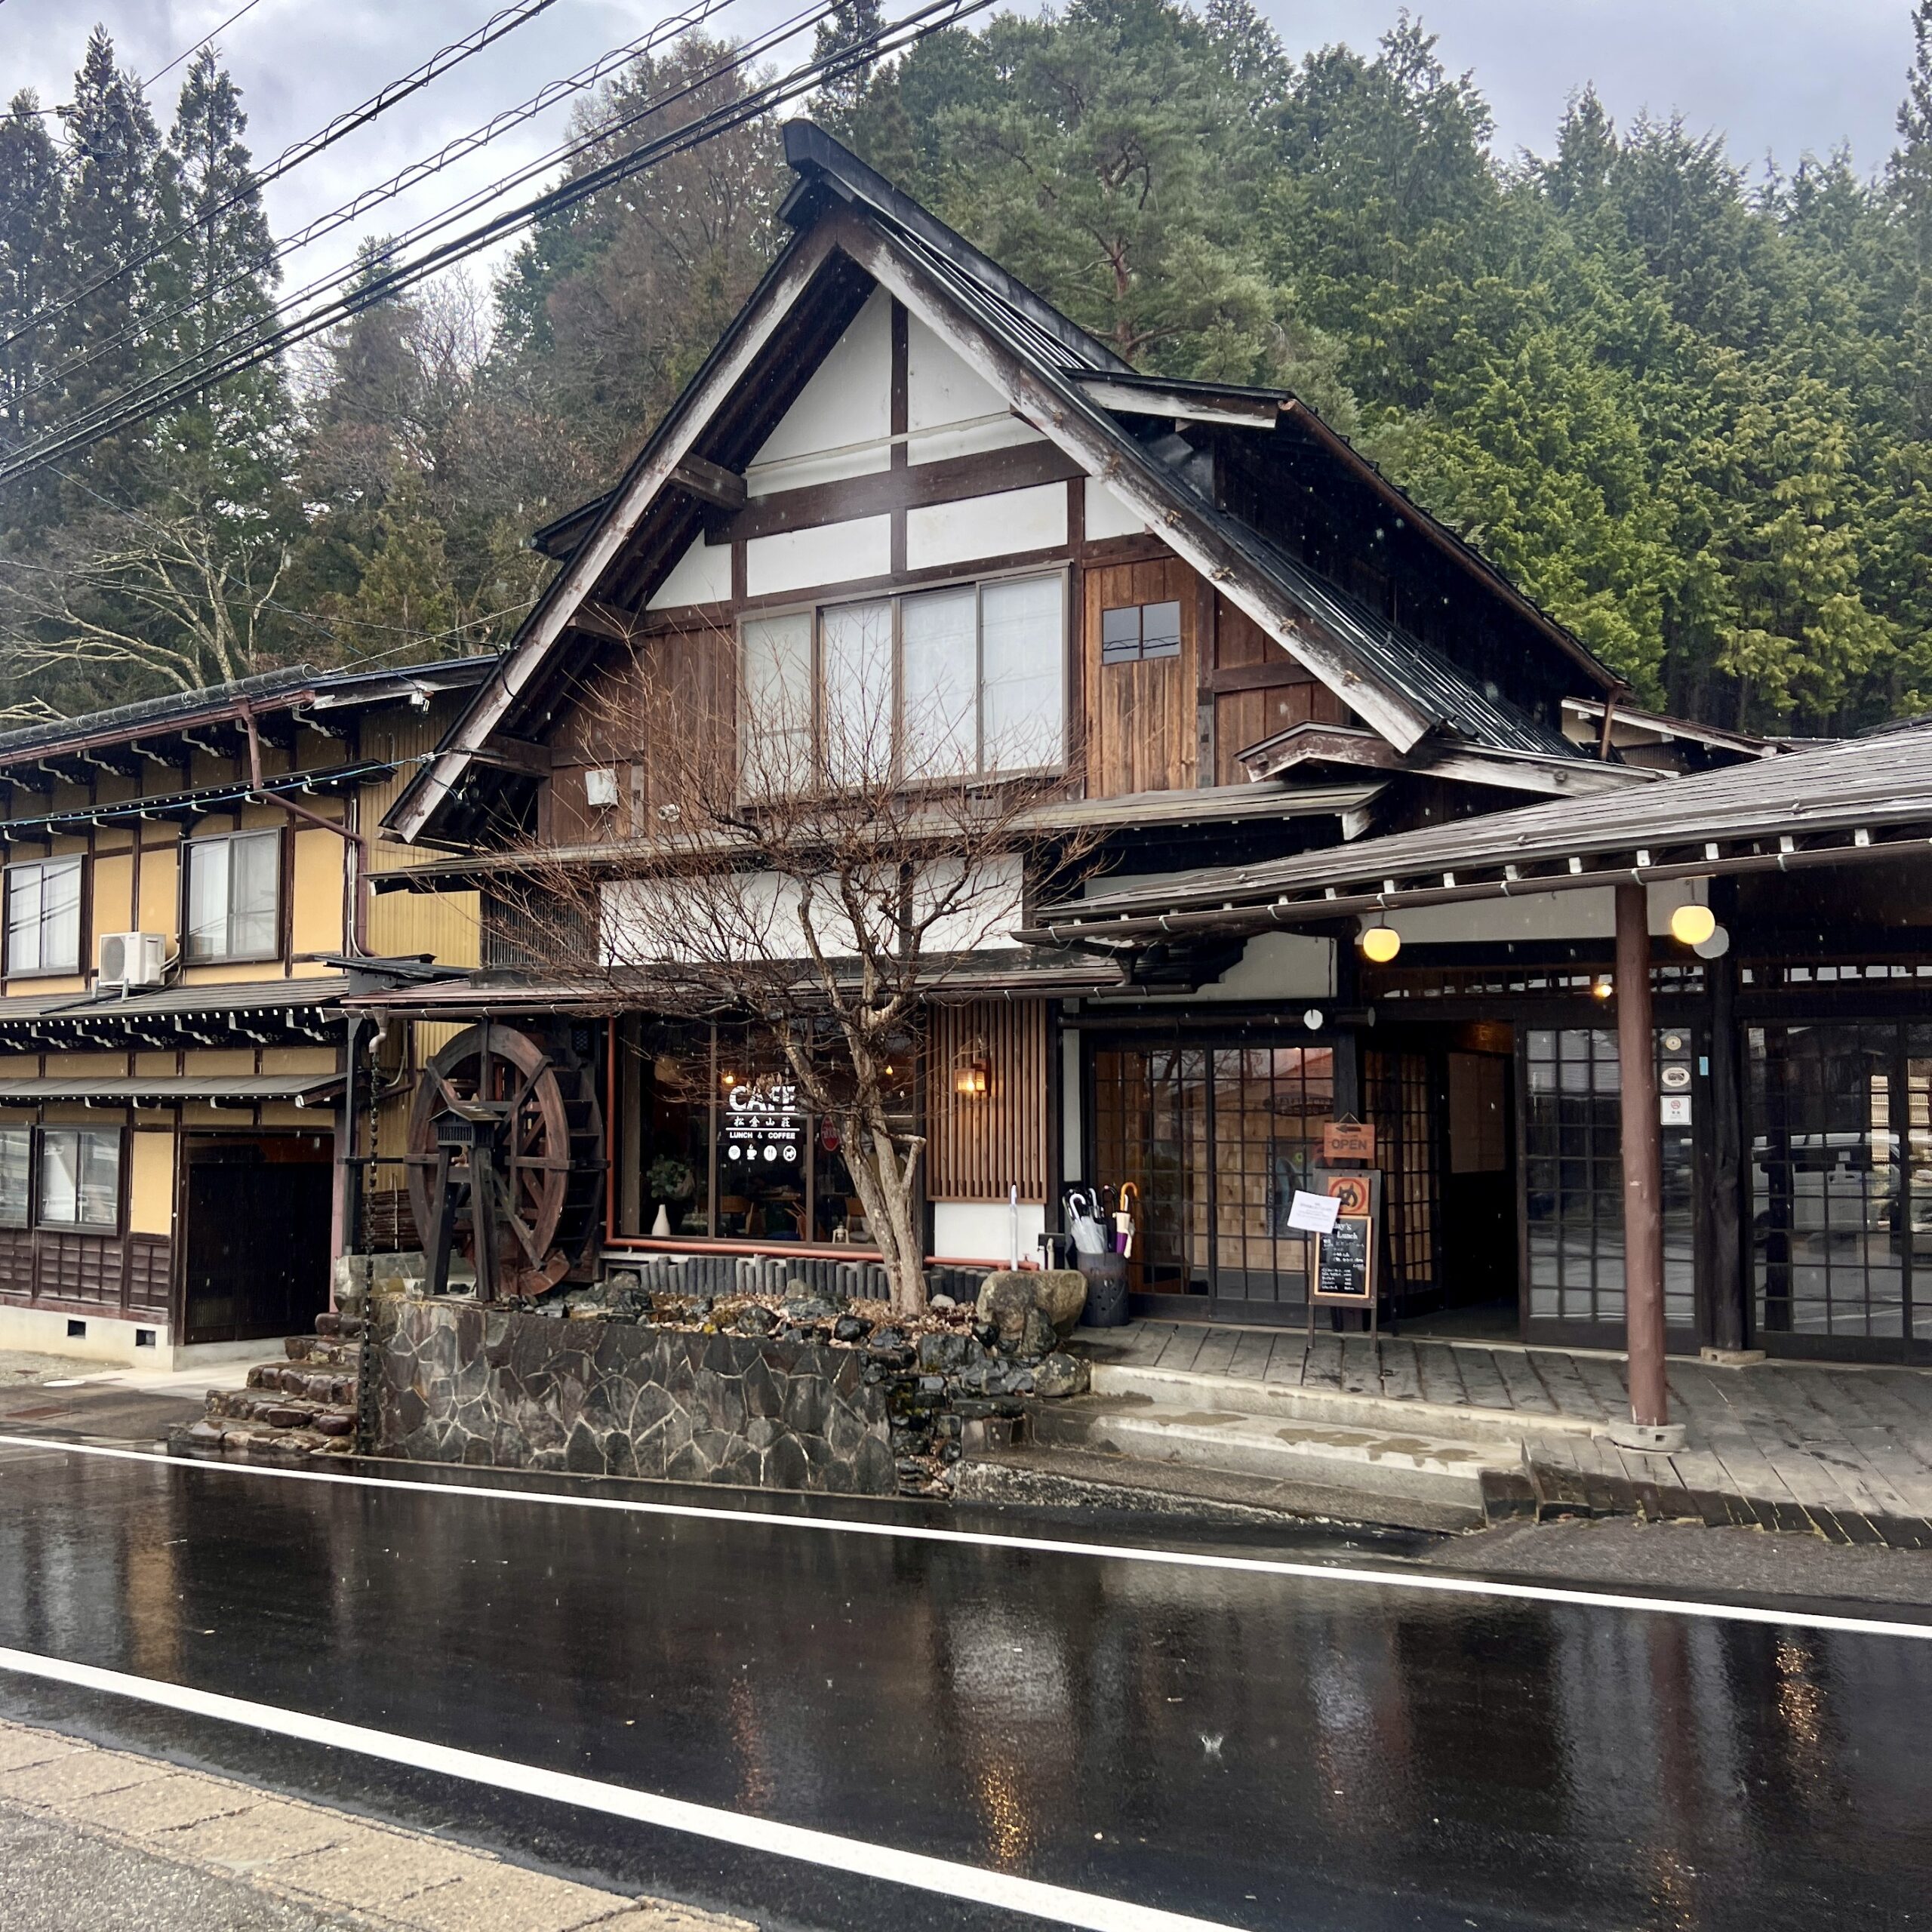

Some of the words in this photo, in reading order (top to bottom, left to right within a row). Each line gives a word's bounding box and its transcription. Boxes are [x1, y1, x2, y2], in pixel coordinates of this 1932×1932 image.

[729, 1085, 795, 1111] CAFE
[1331, 1138, 1367, 1150] OPEN
[1337, 1230, 1358, 1239] Lunch
